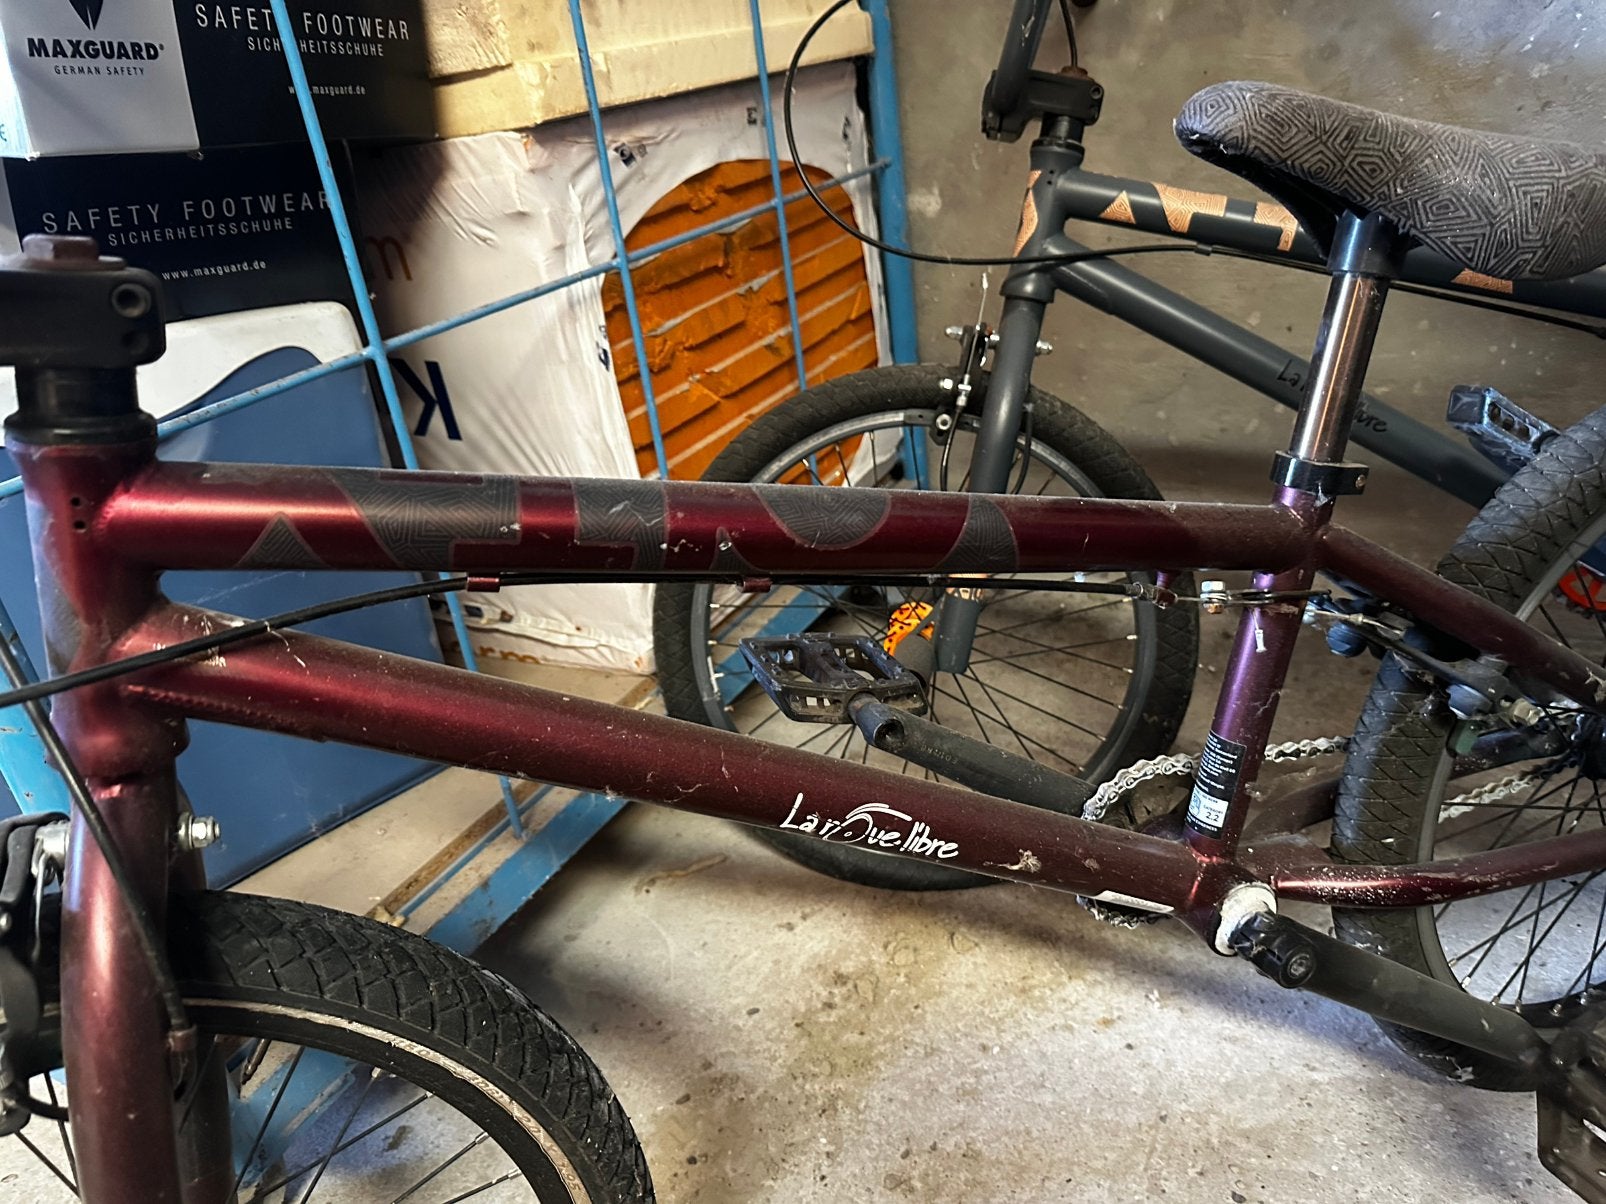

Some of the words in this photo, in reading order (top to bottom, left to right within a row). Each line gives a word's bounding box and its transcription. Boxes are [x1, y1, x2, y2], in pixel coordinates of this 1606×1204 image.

[195, 3, 272, 31] SAFET
[302, 12, 410, 41] FOOTWEAR
[247, 36, 385, 57] SICHHEITSSCHUHE
[54, 65, 101, 76] GERMAN
[106, 66, 145, 76] SAFETY
[288, 84, 367, 97] w.maxguard.de
[42, 203, 161, 234] SAFETY
[183, 189, 332, 221] FOOTWEAR
[108, 216, 294, 248] SICHERHEITSSCHUHE
[161, 259, 268, 282] www.maxguard.de
